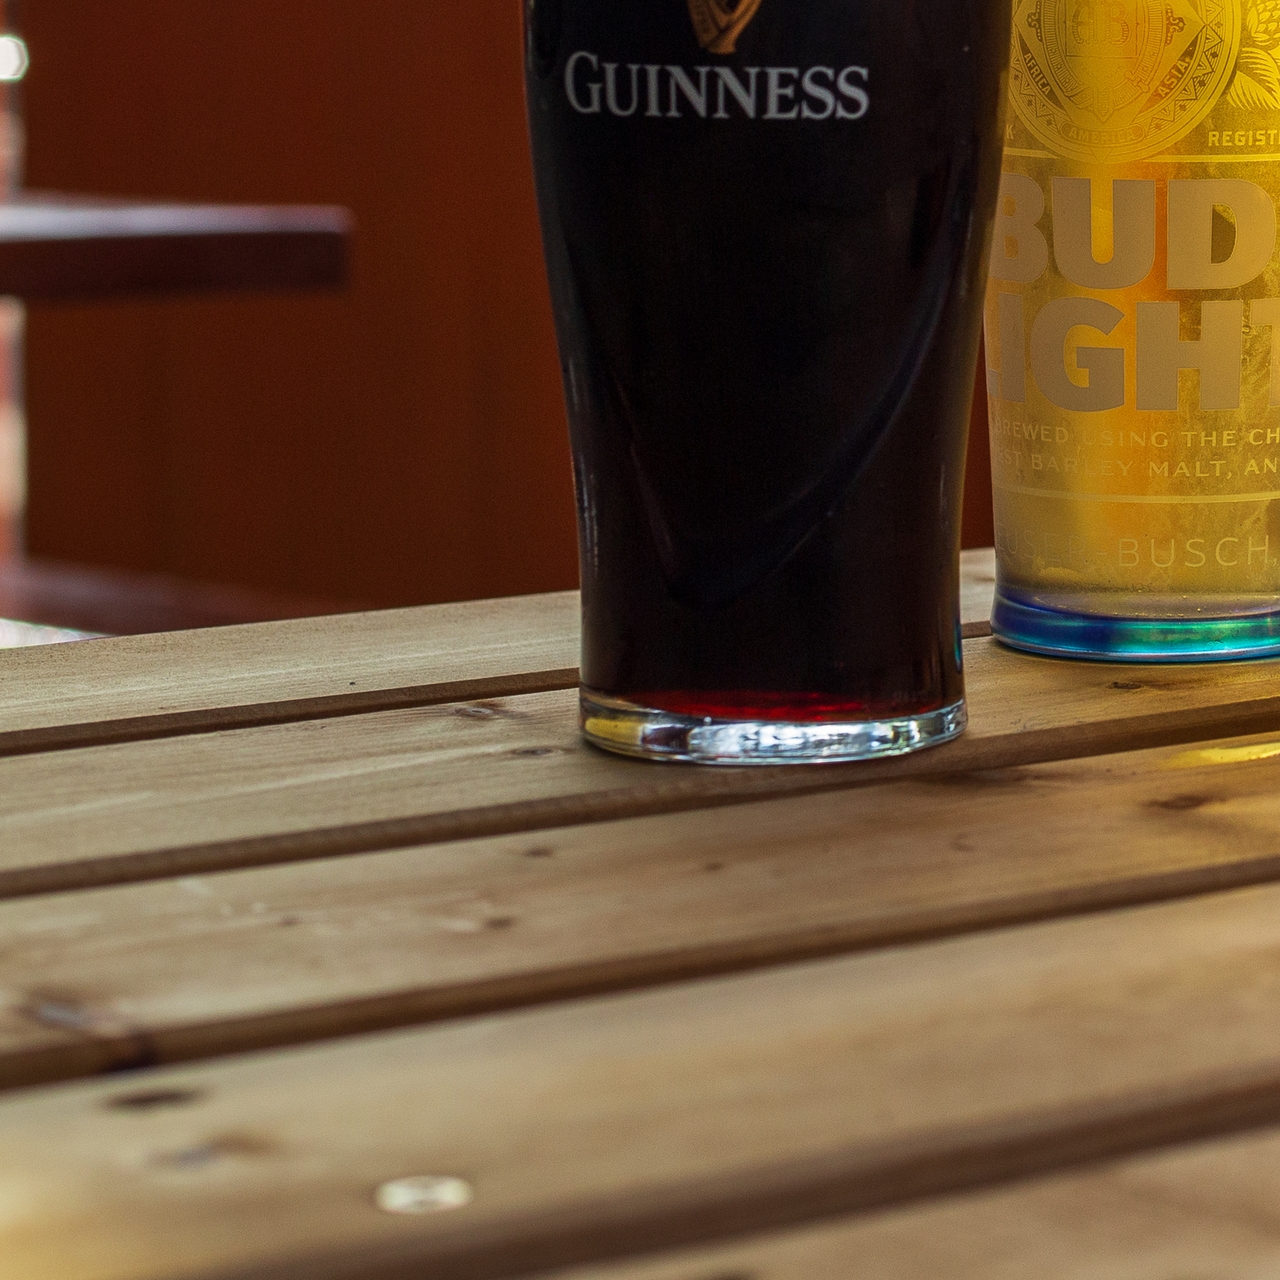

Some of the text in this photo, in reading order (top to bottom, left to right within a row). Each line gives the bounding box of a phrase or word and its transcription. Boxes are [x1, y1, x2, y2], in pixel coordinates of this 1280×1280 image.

[564, 51, 870, 120] GUINNESS
[1024, 52, 1051, 96] AFRICA
[1158, 60, 1190, 97] ASIA
[1069, 126, 1135, 144] AMERICA
[989, 172, 1276, 289] BUD
[1081, 429, 1170, 448] USING
[1181, 430, 1237, 448] THE
[1031, 453, 1134, 477] BARLEY
[1149, 460, 1233, 480] MALT,
